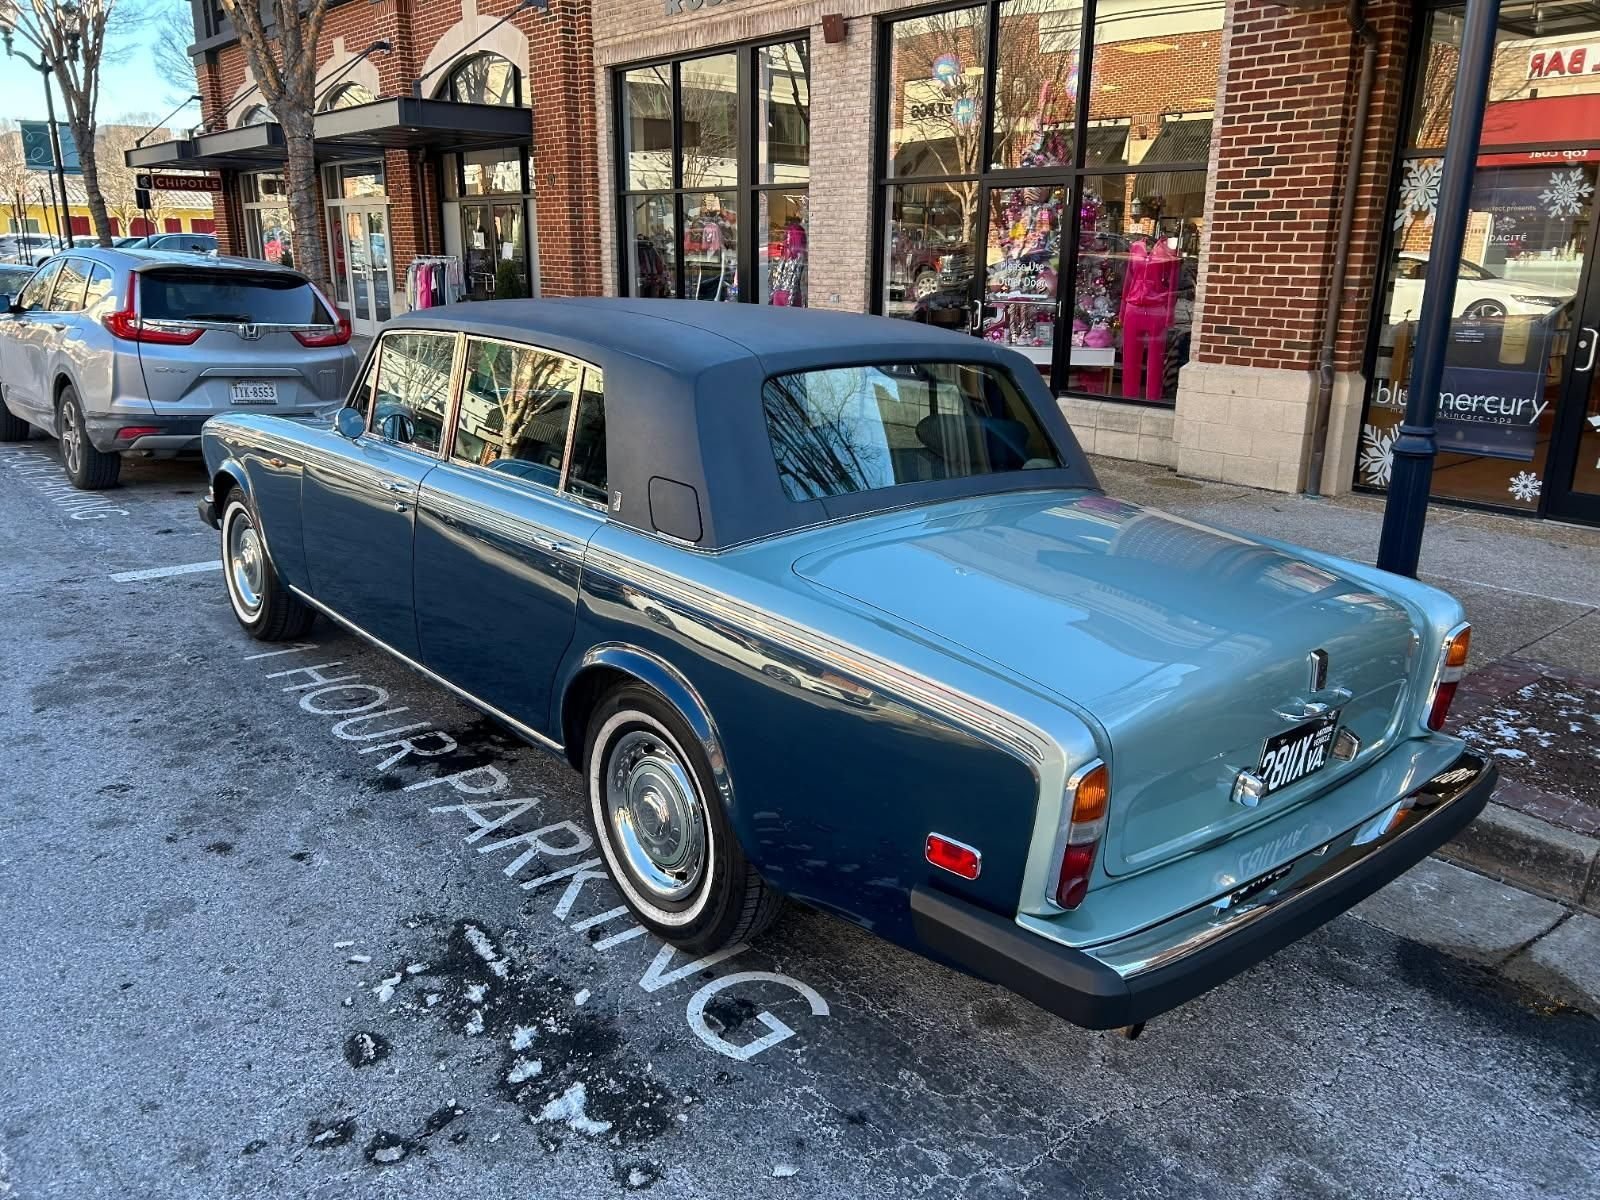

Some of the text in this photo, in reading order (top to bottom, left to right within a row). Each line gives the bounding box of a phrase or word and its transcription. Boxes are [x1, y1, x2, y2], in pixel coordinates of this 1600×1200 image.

[156, 178, 219, 189] CHIPOTLE
[1487, 232, 1528, 242] DACITÉ
[1000, 260, 1044, 272] Please Use
[1023, 276, 1048, 288] Door
[233, 386, 275, 398] TYK-8553
[1437, 410, 1484, 422] skincare
[244, 643, 830, 1062] 1 HOUR PARKING
